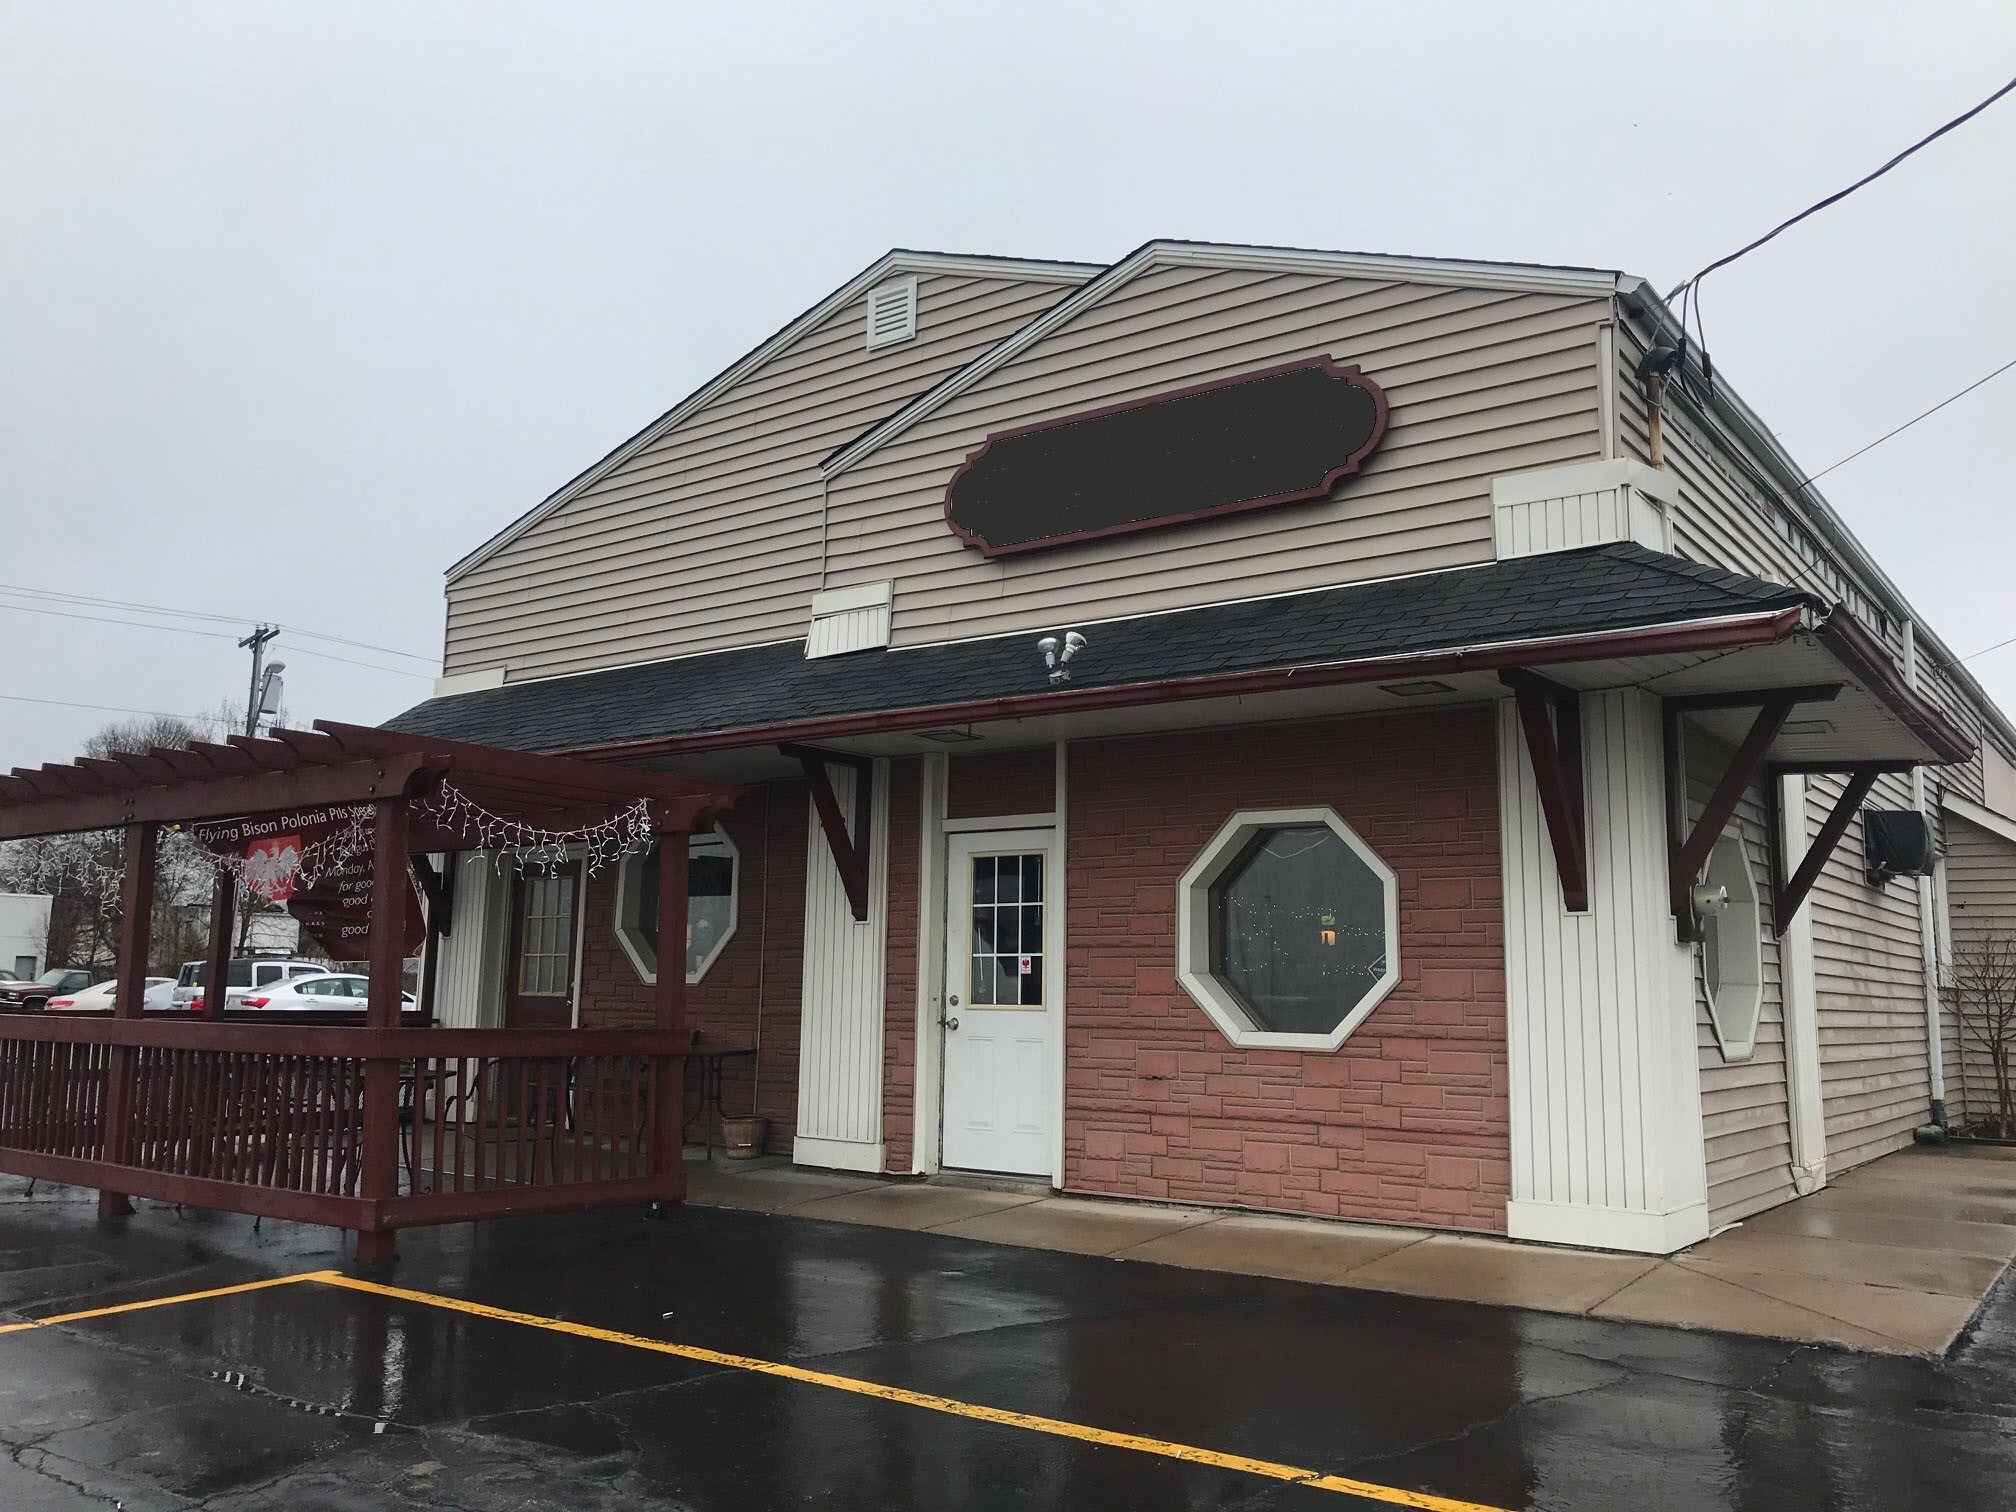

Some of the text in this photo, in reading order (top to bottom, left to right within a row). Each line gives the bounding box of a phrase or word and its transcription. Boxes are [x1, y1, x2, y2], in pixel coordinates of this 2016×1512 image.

[199, 826, 239, 843] Flying
[242, 820, 278, 836] Bison
[281, 810, 328, 830] Polonia
[329, 807, 348, 821] Pils
[337, 879, 374, 894] for goo
[342, 893, 368, 908] good
[341, 922, 369, 938] good
